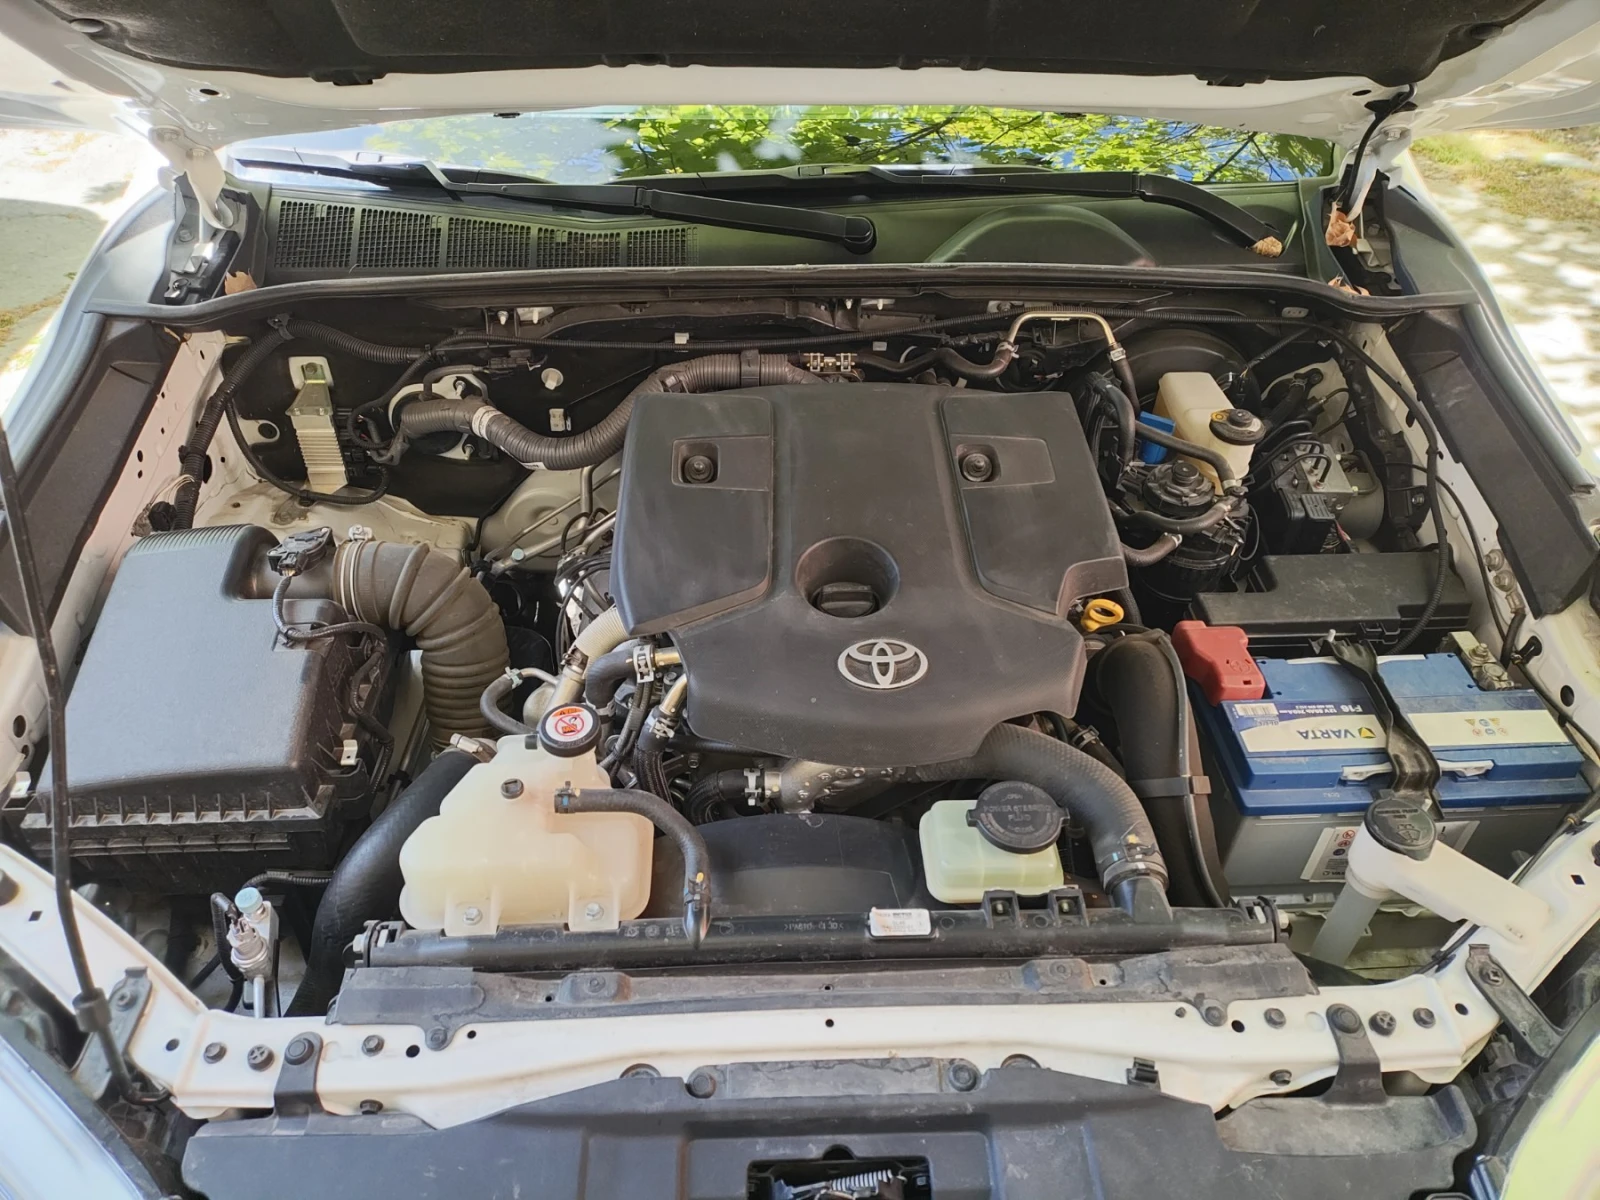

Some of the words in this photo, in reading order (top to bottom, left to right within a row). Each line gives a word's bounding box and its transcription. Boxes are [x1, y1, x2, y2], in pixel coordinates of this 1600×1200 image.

[1340, 704, 1363, 713] F16
[1296, 728, 1356, 740] VARTA
[983, 804, 1012, 813] POWER
[1007, 813, 1031, 821] FLUID
